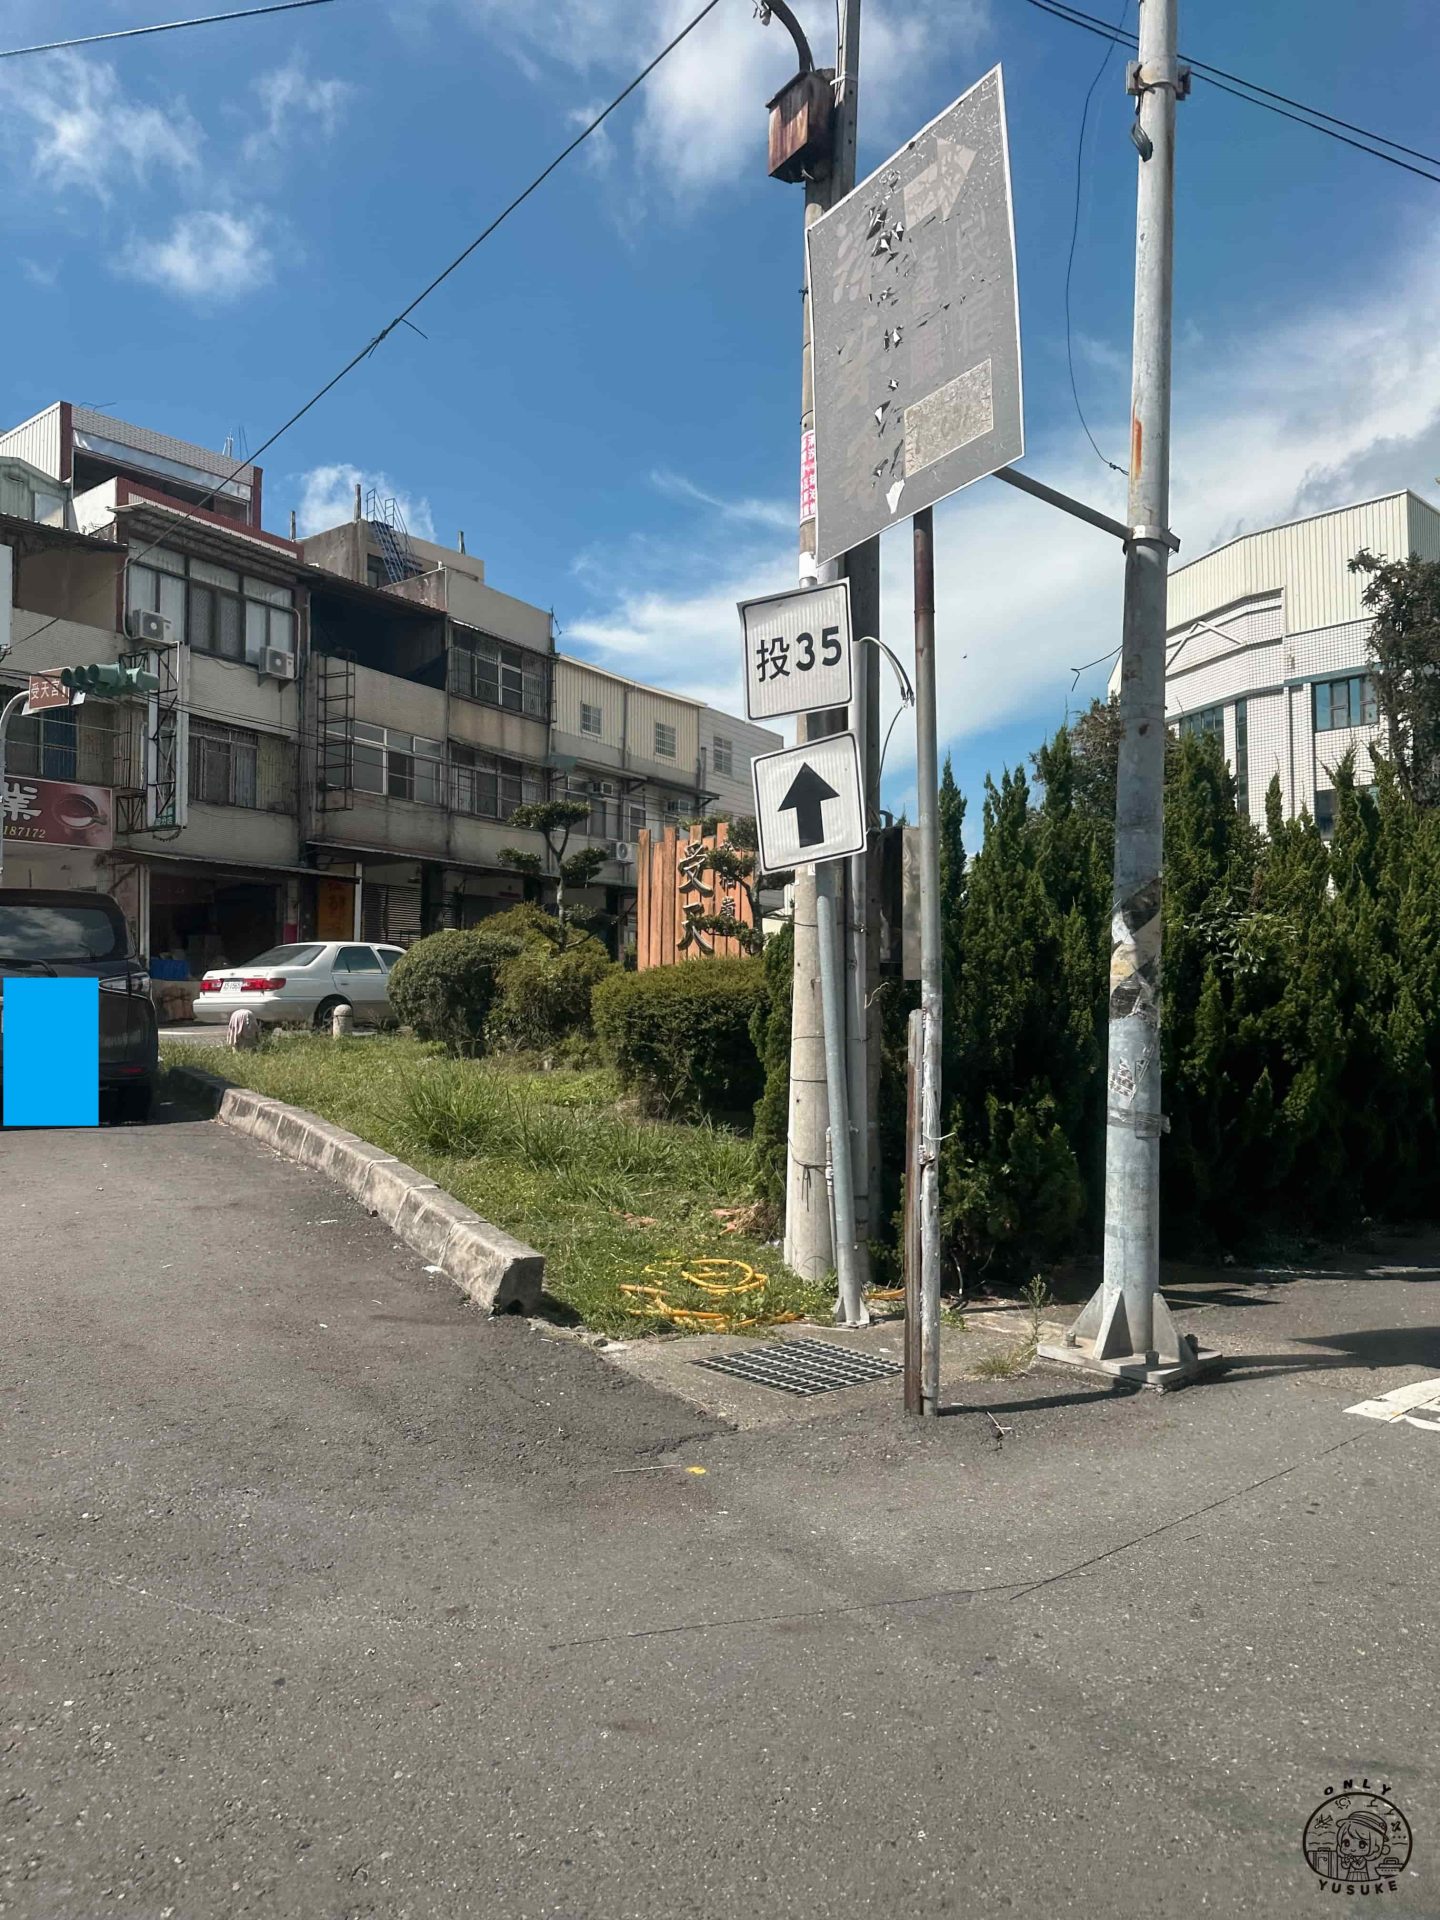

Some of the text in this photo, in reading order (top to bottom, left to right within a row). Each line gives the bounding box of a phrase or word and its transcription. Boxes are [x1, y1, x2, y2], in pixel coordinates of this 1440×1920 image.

[756, 626, 842, 682] 投35
[31, 679, 60, 700] 受天宮
